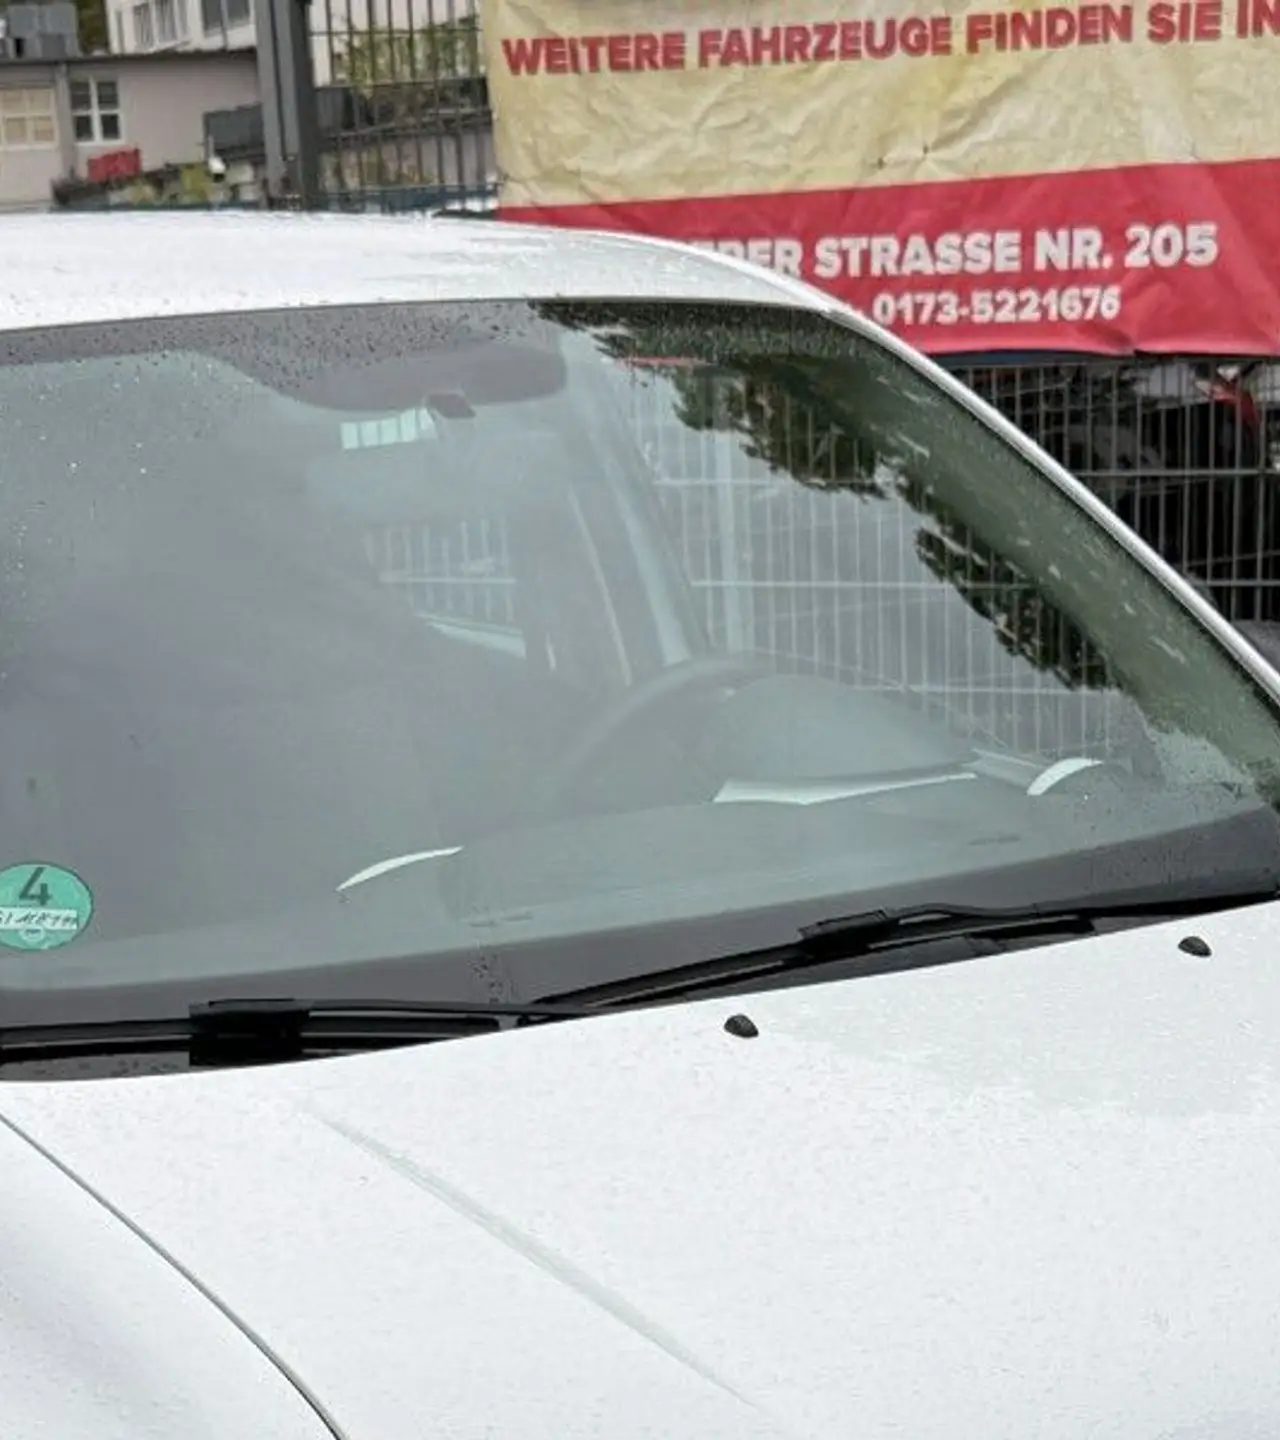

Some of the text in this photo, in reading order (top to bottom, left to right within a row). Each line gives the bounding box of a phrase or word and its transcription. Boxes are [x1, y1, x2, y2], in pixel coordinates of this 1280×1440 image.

[502, 31, 686, 76] WEITERE
[698, 17, 953, 68] FAHRZEUGE
[966, 4, 1133, 54] FINDEN
[1147, 1, 1222, 44] SIE
[814, 230, 1023, 279] STRASSE
[1034, 225, 1114, 271] NR.
[1124, 221, 1219, 268] 205
[872, 285, 1122, 326] 0173-5221676
[18, 866, 53, 907] 4
